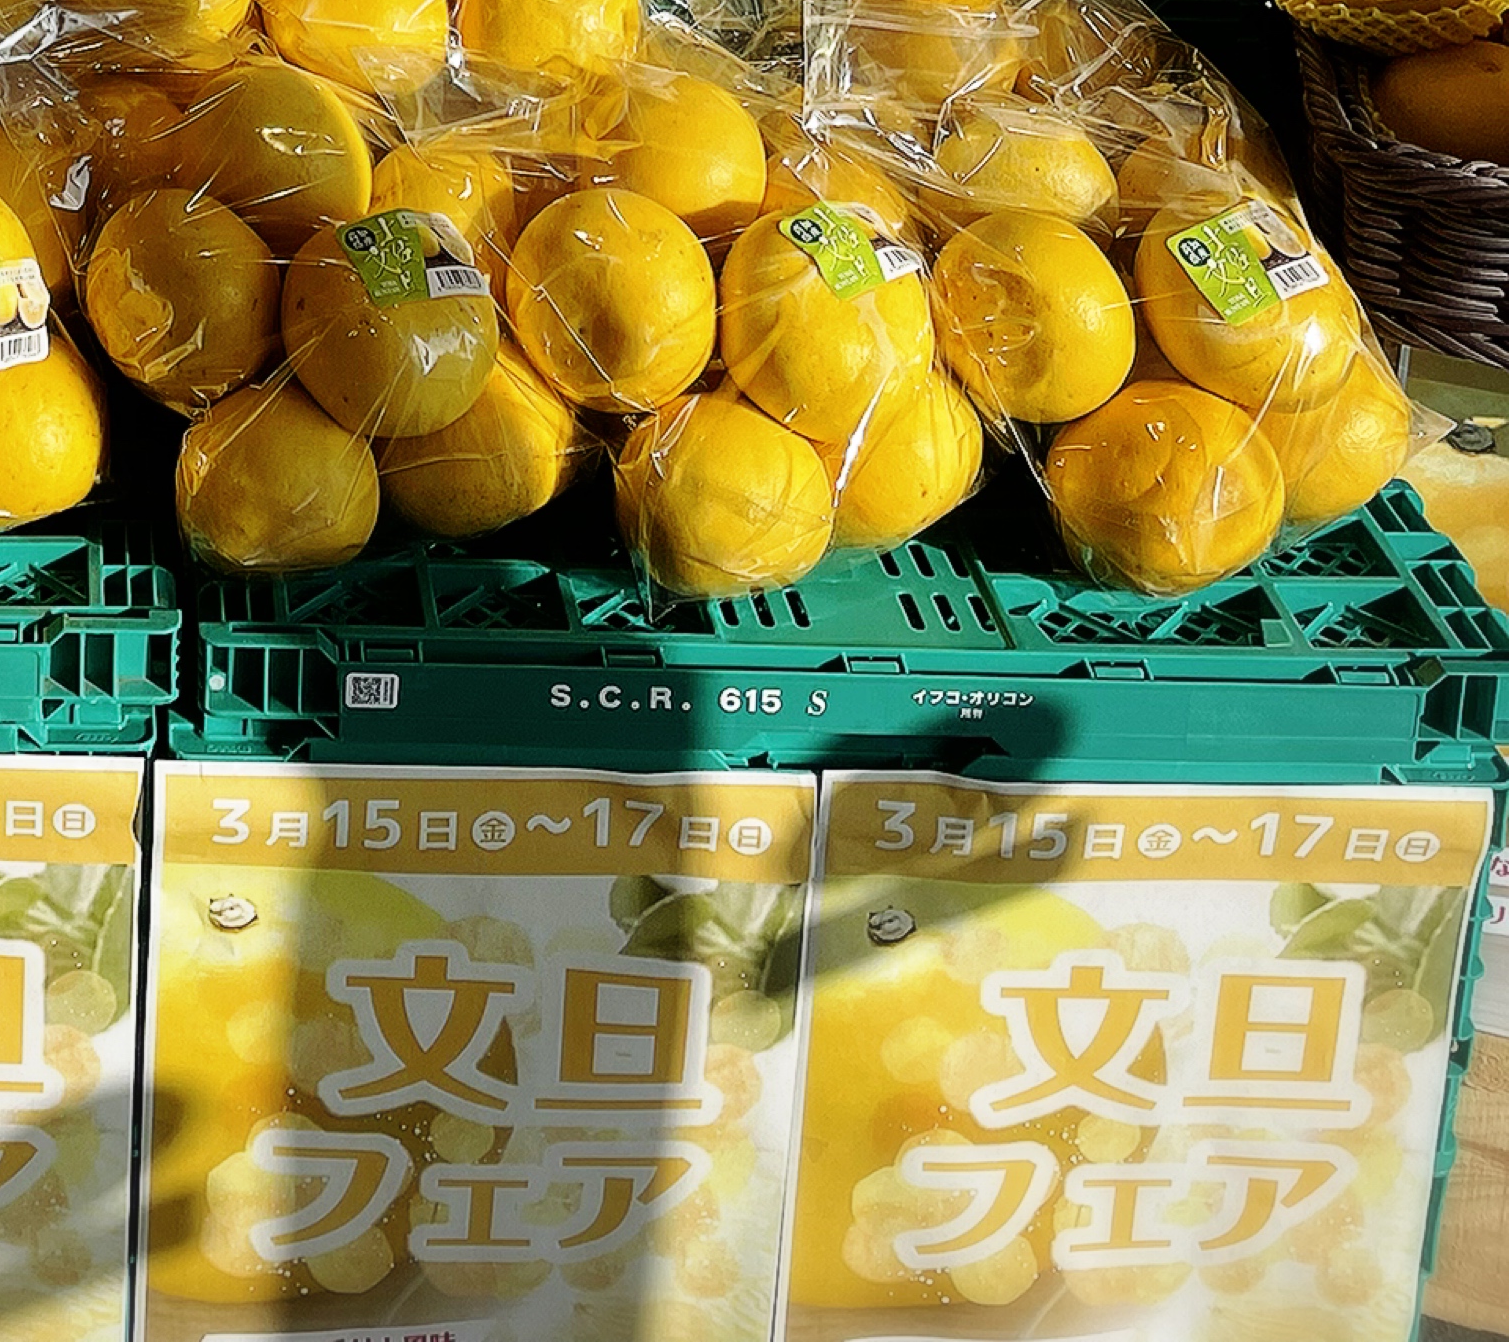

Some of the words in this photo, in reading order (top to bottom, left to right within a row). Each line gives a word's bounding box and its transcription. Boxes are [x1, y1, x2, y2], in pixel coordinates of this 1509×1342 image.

[549, 683, 693, 712] S.C.R.
[719, 688, 783, 715] 615
[807, 690, 829, 718] S
[338, 955, 702, 1111] 文旦
[988, 966, 1351, 1114] 文旦
[269, 1145, 693, 1249] フェア
[915, 1155, 1339, 1256] フェア
